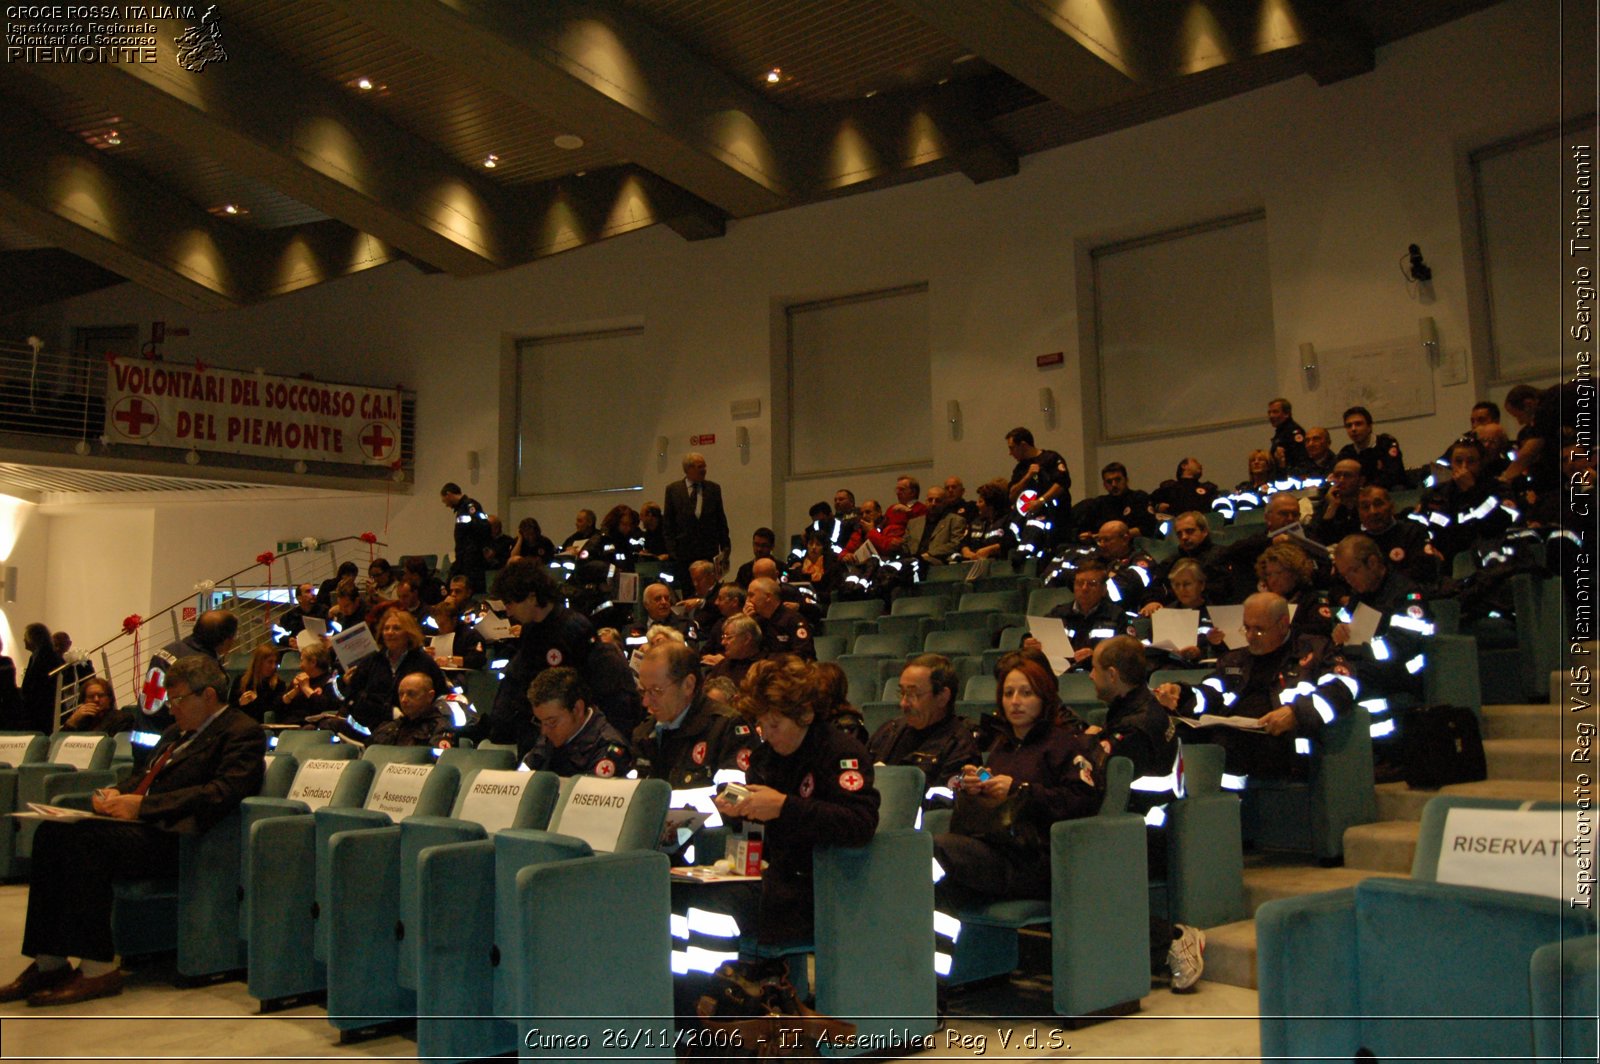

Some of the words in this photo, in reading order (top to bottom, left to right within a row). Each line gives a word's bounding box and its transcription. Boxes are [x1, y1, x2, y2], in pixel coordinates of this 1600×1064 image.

[114, 363, 225, 403] VOLONTARI
[231, 378, 261, 406] DEL
[265, 381, 355, 417] SOCCORSO
[176, 411, 217, 441] DEL
[227, 417, 344, 452] PIEMONTE
[386, 765, 428, 776] RISERVATO
[302, 787, 332, 798] Sindaco
[473, 783, 520, 796] RISERVATO
[383, 792, 418, 804] Assessore
[572, 793, 625, 809] RISERVATO
[1453, 835, 1578, 857] RISERVATO
